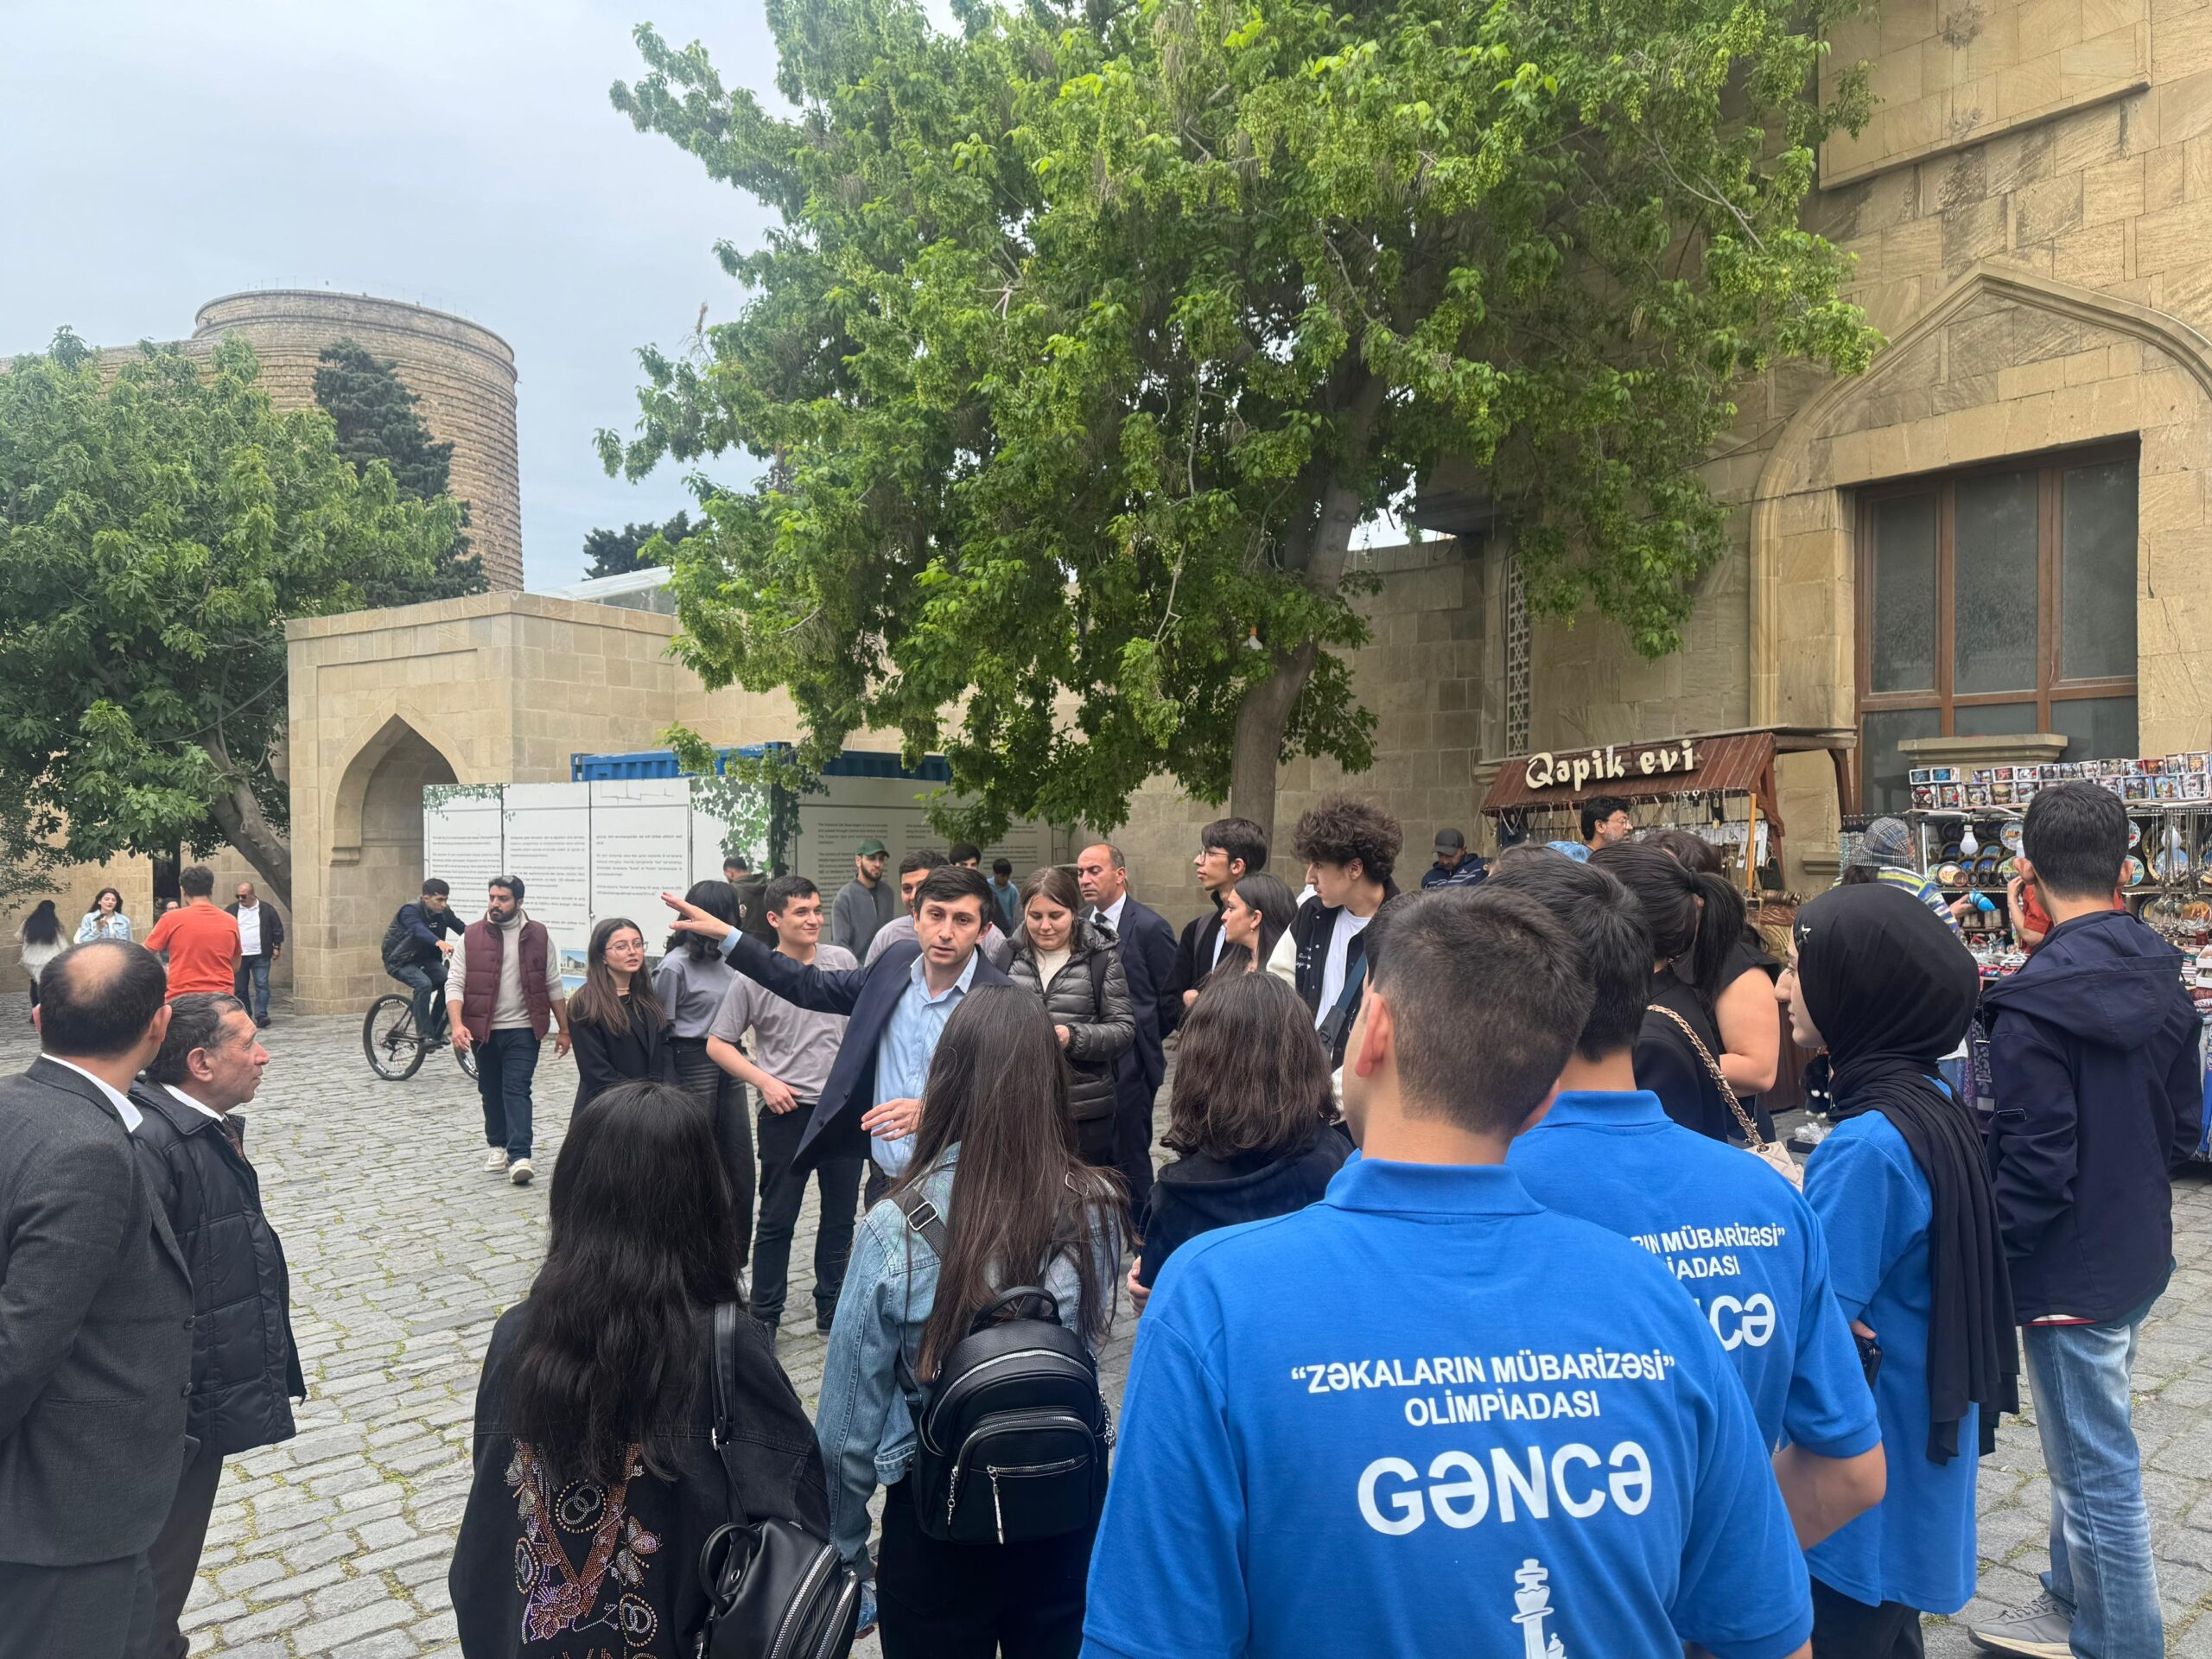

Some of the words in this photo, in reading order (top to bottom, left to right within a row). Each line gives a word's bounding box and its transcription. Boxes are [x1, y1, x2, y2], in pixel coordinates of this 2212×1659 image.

[1639, 739, 1694, 775] evi
[1404, 1389, 1600, 1427] OLİMPİADASI
[1357, 1440, 1652, 1535] GƏNCƏ
